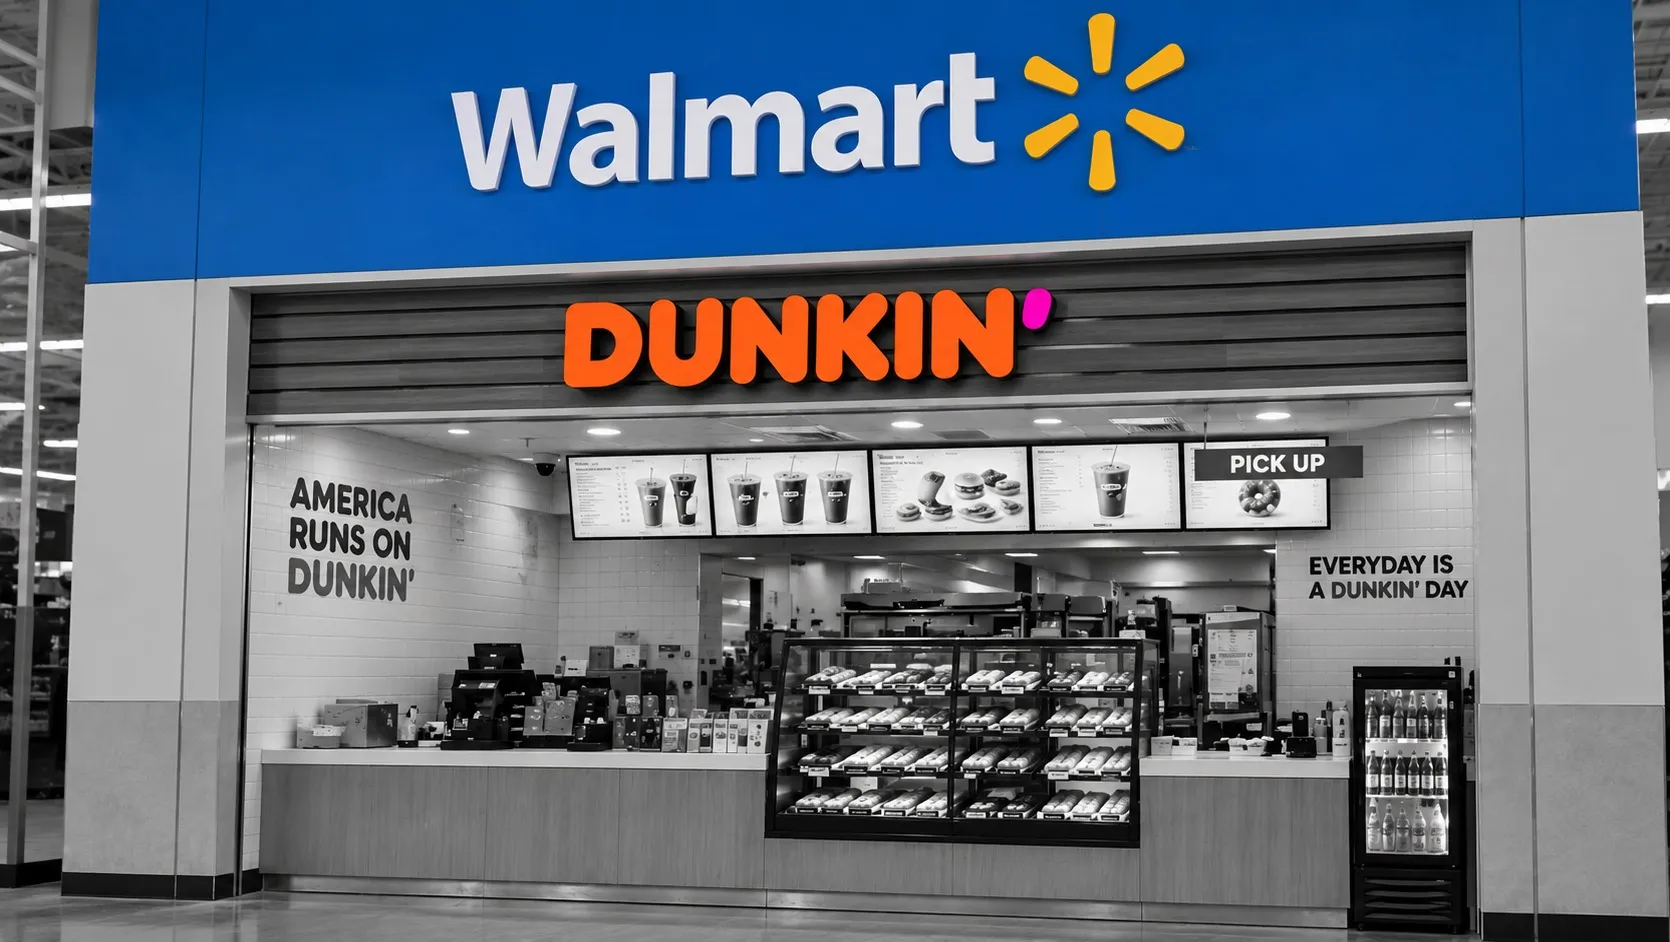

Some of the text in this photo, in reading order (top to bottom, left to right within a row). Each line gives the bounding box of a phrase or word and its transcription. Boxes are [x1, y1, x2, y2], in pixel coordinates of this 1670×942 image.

[452, 52, 996, 191] Walmart
[563, 286, 1053, 388] DUNKIN'
[1230, 453, 1326, 474] PICK UP
[289, 477, 413, 525] AMERICA
[289, 516, 411, 561] RUNS ON
[287, 556, 415, 603] DUNKIN'
[1309, 554, 1454, 576] EVERYDAY IS
[1308, 579, 1469, 600] A DUNKIN' DAY
